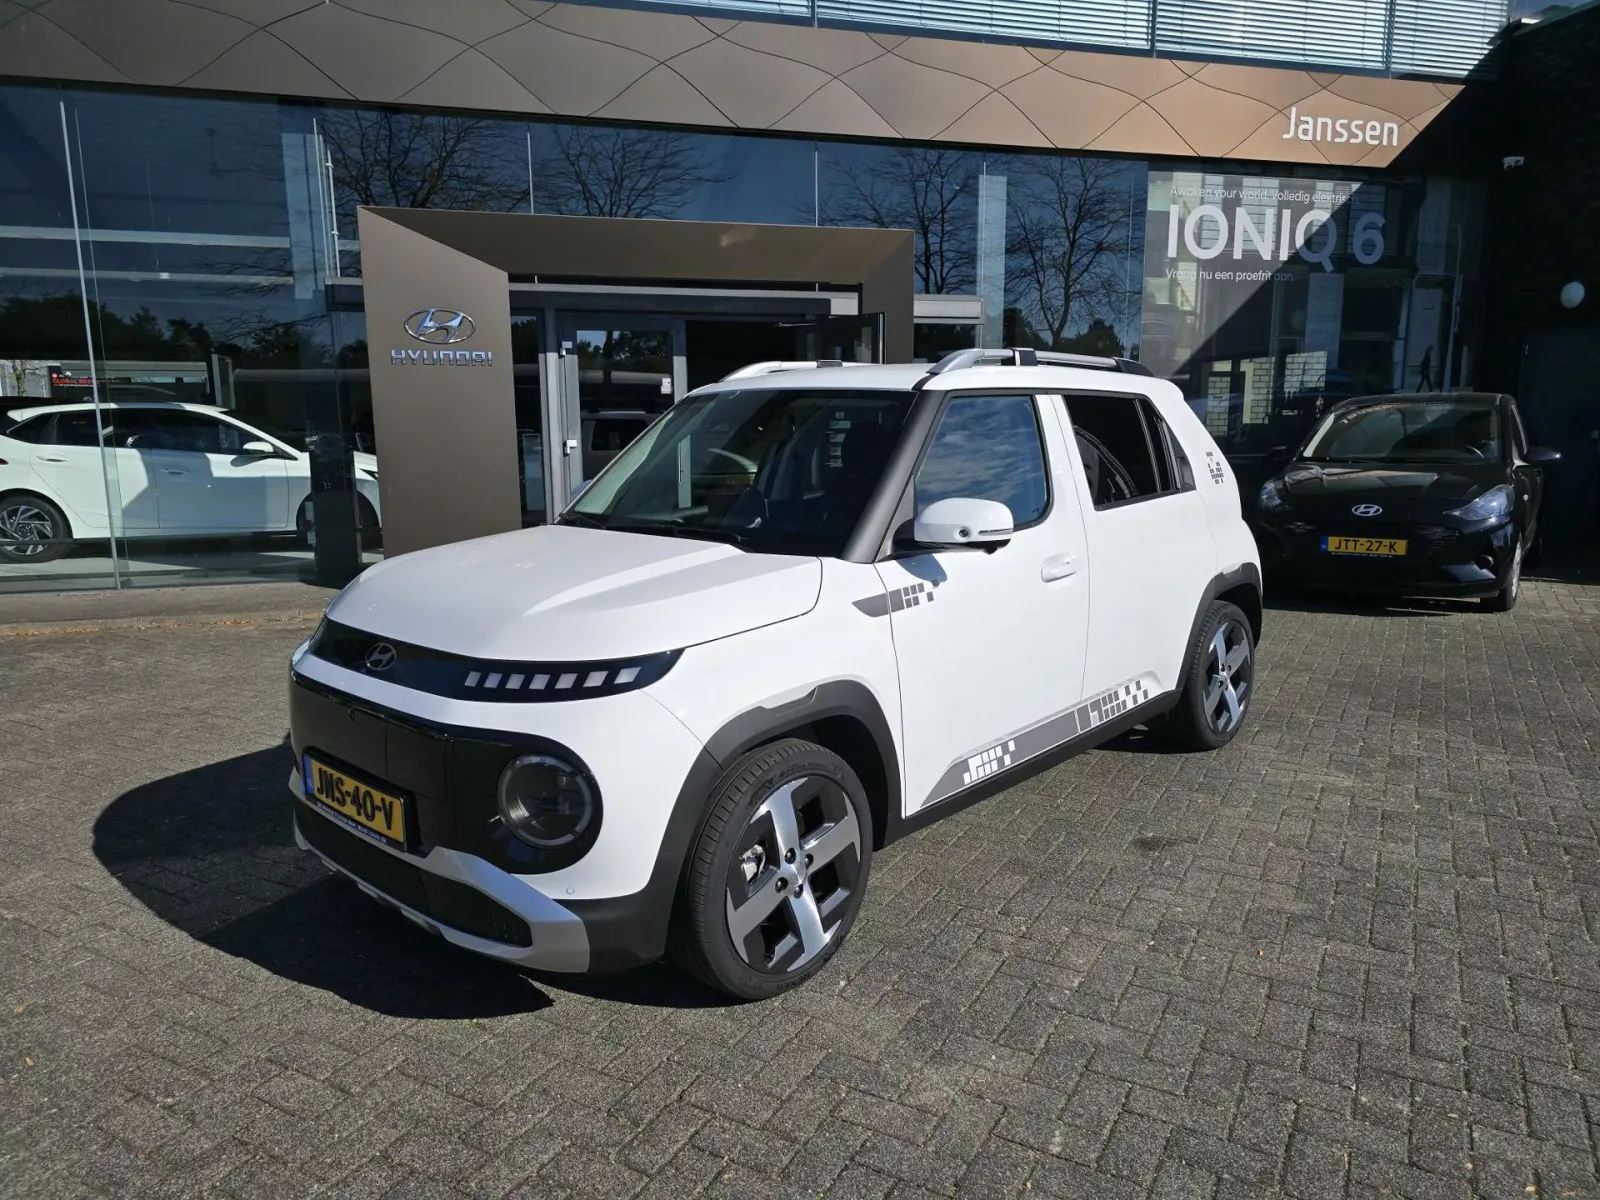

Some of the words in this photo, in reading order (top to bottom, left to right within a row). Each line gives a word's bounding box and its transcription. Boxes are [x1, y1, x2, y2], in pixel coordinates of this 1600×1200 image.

[1282, 107, 1399, 146] Janssen
[1169, 185, 1212, 197] Awaken
[1214, 189, 1236, 200] your
[1167, 204, 1338, 273] IONIQ
[1352, 211, 1386, 265] 6
[1214, 270, 1234, 281] een
[1235, 269, 1272, 283] proefrit
[391, 349, 493, 367] HYUNDAI
[1334, 538, 1397, 553] JTT-27-K
[317, 767, 394, 831] JNS-40-V
